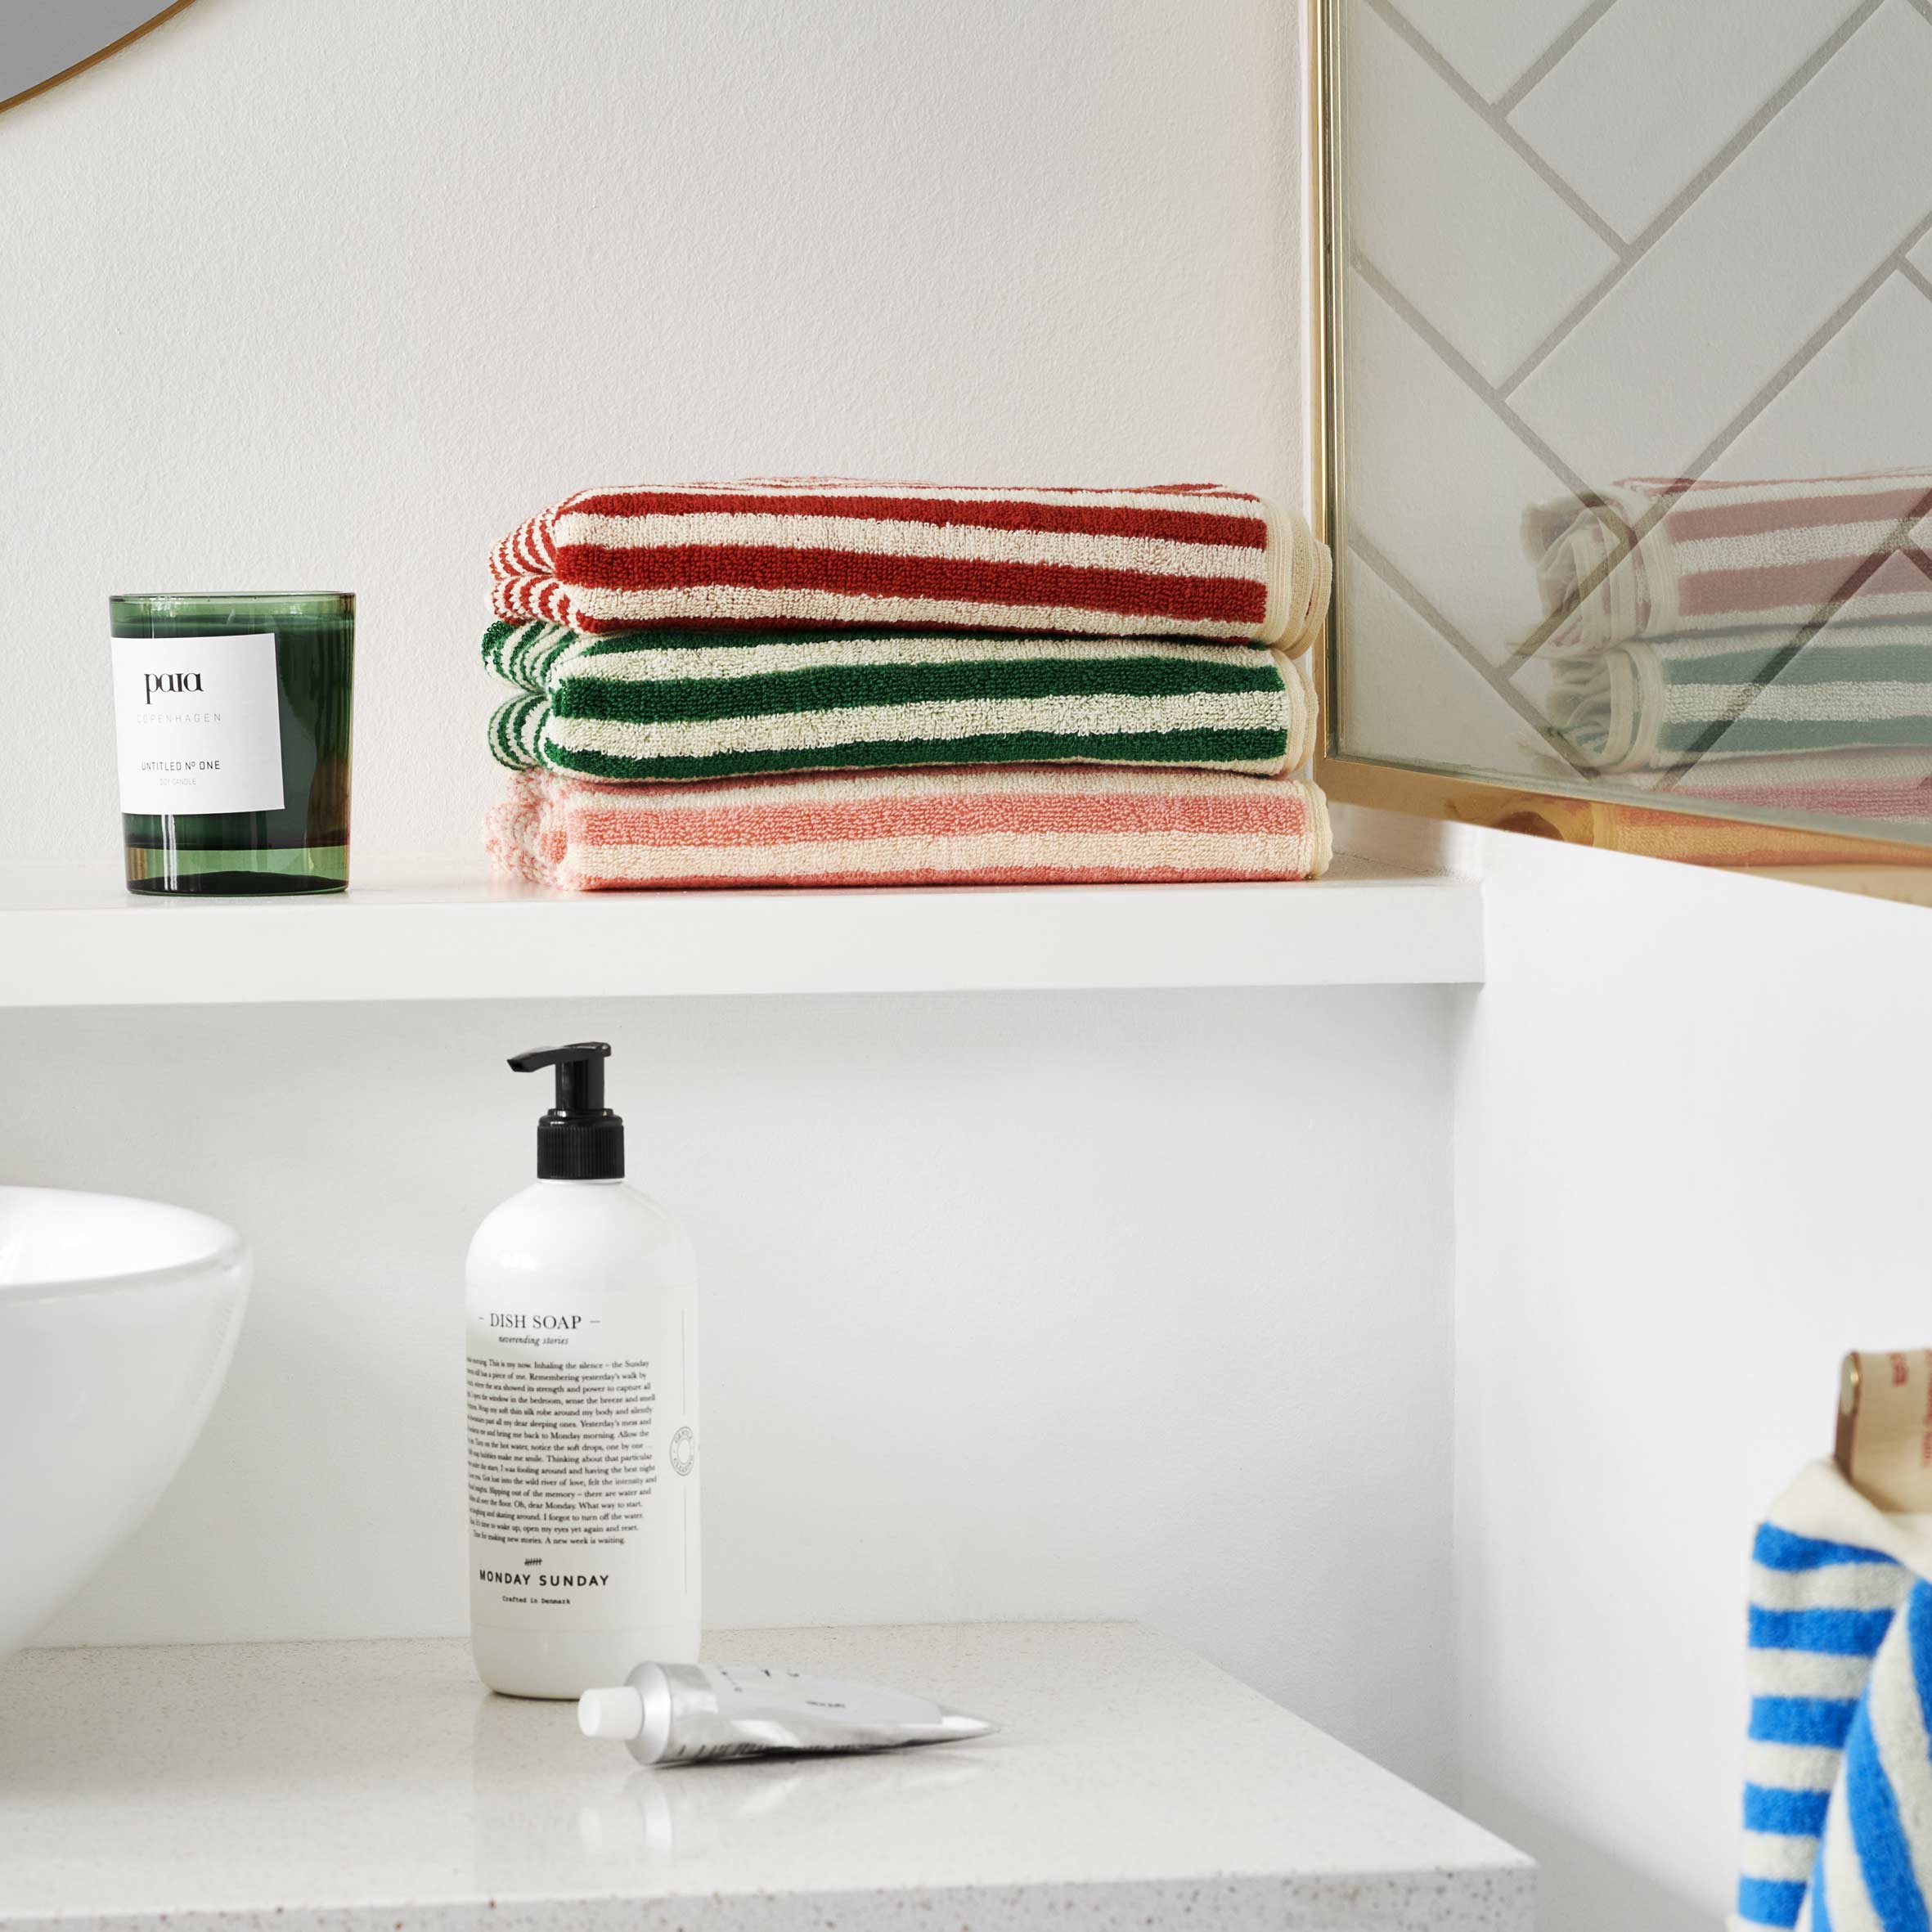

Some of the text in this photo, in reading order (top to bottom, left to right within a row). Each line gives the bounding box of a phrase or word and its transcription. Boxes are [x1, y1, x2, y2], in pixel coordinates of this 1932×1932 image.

[137, 713, 222, 724] COPENHAGEN
[142, 762, 182, 771] UNTITLED
[200, 761, 221, 770] ONE
[490, 1312, 582, 1330] DISH SOAP
[498, 1336, 568, 1346] neverending stories
[488, 1359, 500, 1367] This
[534, 1361, 563, 1371] Inhaling
[625, 1359, 649, 1368] Sunday
[529, 1373, 579, 1382] Remembering
[582, 1373, 620, 1382] yesterday's
[536, 1386, 564, 1394] strength
[567, 1385, 581, 1393] and
[582, 1386, 604, 1395] power
[616, 1384, 641, 1393] capture
[530, 1397, 563, 1405] bedroom,
[595, 1408, 613, 1418] body
[631, 1406, 653, 1414] silently
[530, 1420, 557, 1428] sleeping
[580, 1420, 620, 1428] Yesterday's
[496, 1431, 511, 1440] bring
[550, 1431, 581, 1441] Monday
[640, 1429, 649, 1437] the
[582, 1444, 604, 1453] drops,
[547, 1455, 579, 1464] Thinking
[604, 1454, 618, 1462] that
[620, 1453, 653, 1463] particular
[517, 1466, 539, 1476] fooling
[585, 1467, 609, 1475] having
[569, 1479, 586, 1487] love,
[615, 1476, 643, 1485] intensity
[645, 1475, 657, 1483] and
[545, 1491, 575, 1499] memory
[640, 1487, 651, 1495] and
[514, 1500, 526, 1508] Oh,
[496, 1512, 514, 1521] skating
[549, 1513, 570, 1522] forgot
[583, 1525, 604, 1534] again
[606, 1524, 619, 1532] and
[487, 1534, 505, 1543] making
[479, 1570, 609, 1587] MONDAY SUNDAY
